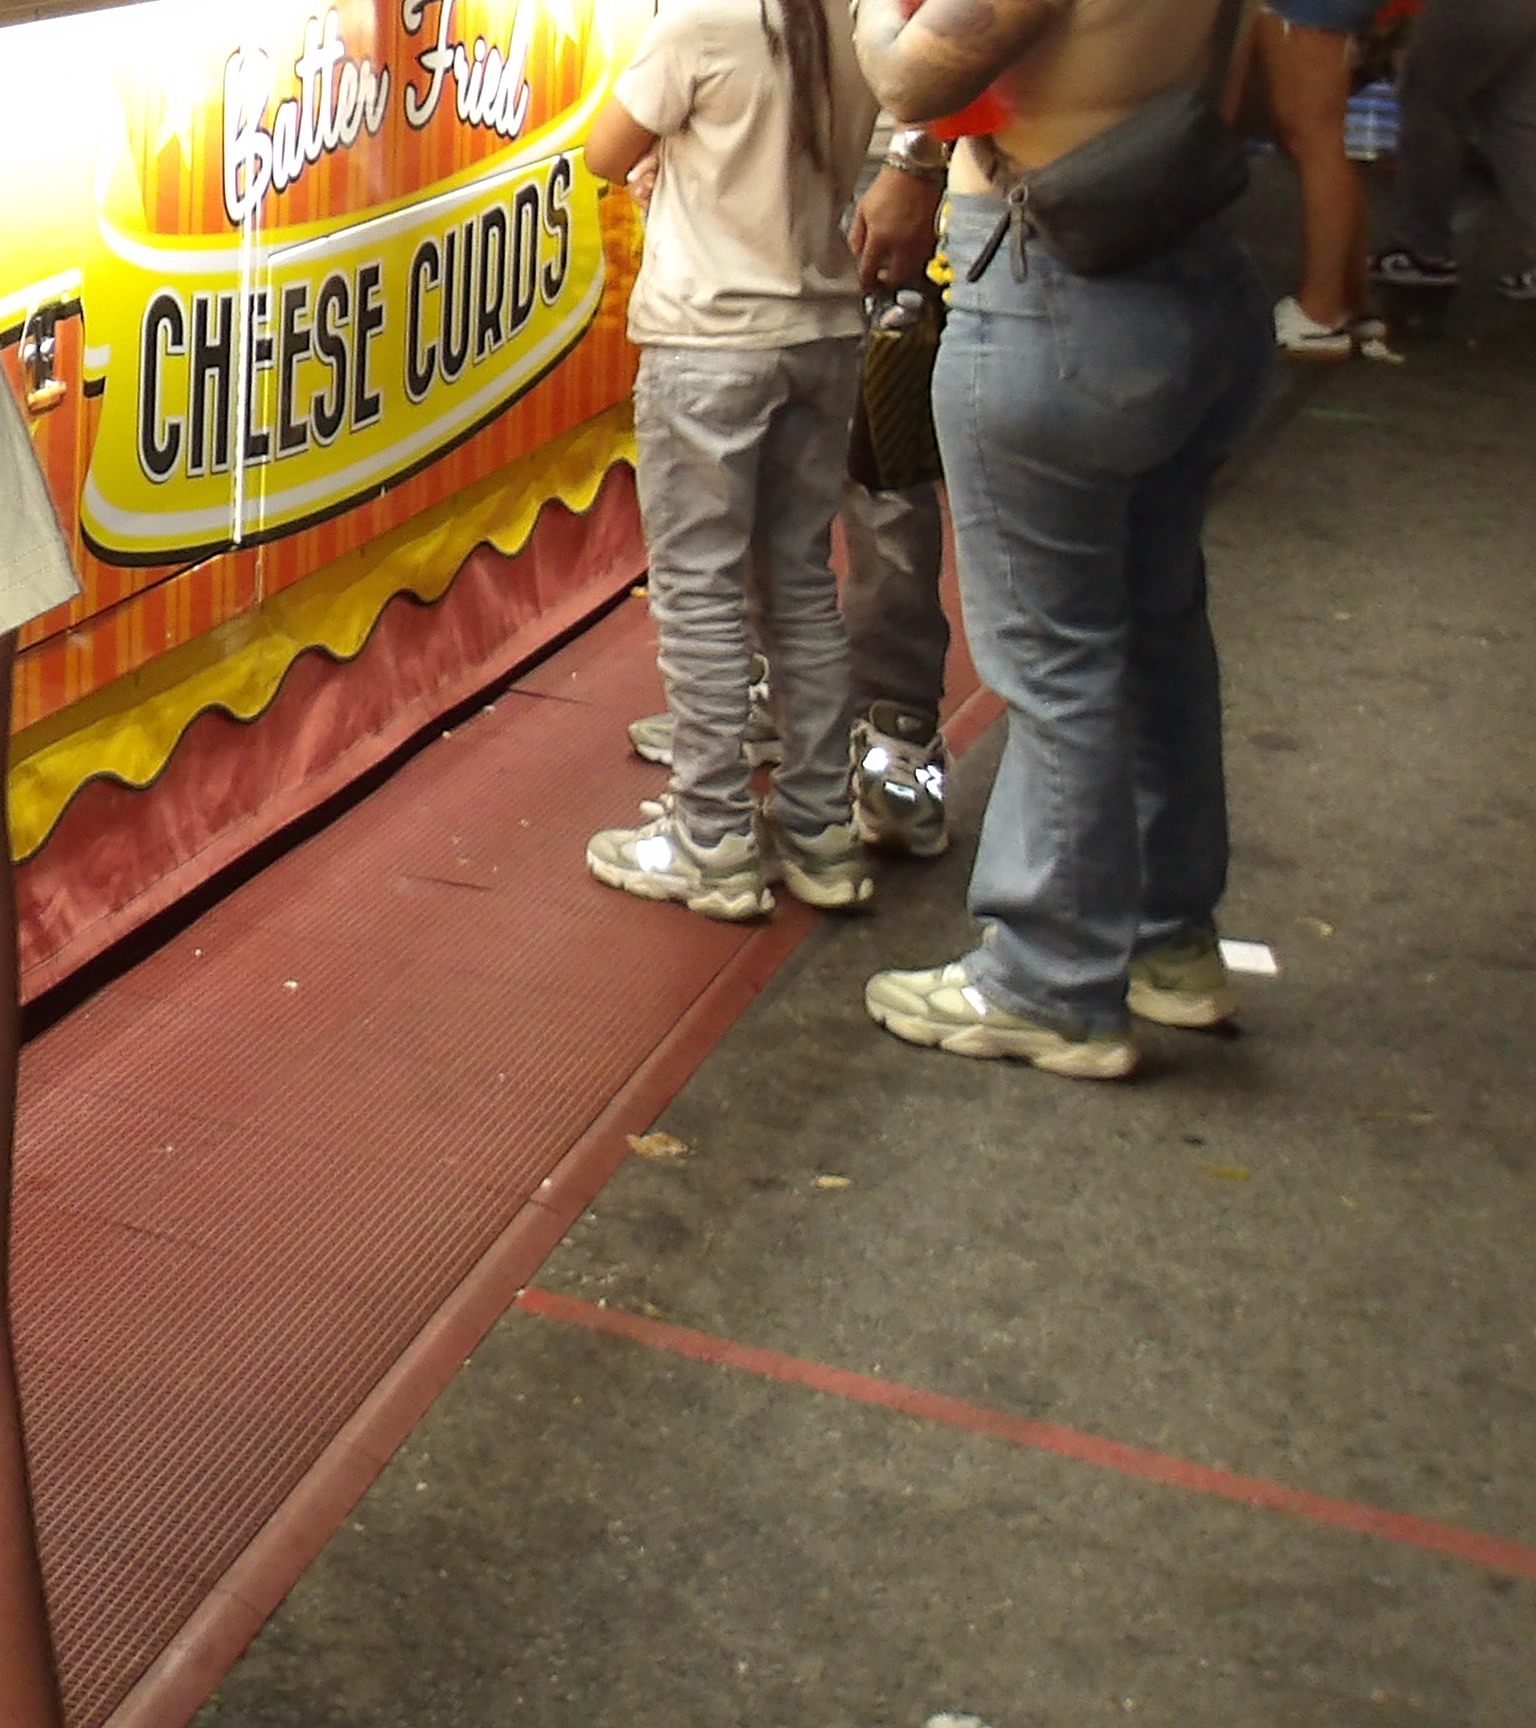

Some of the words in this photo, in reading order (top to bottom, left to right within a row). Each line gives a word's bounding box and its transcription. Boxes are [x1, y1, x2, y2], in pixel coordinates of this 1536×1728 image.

[222, 7, 390, 228] Batter
[137, 260, 388, 483] CHEESE
[403, 150, 574, 405] CURDS
